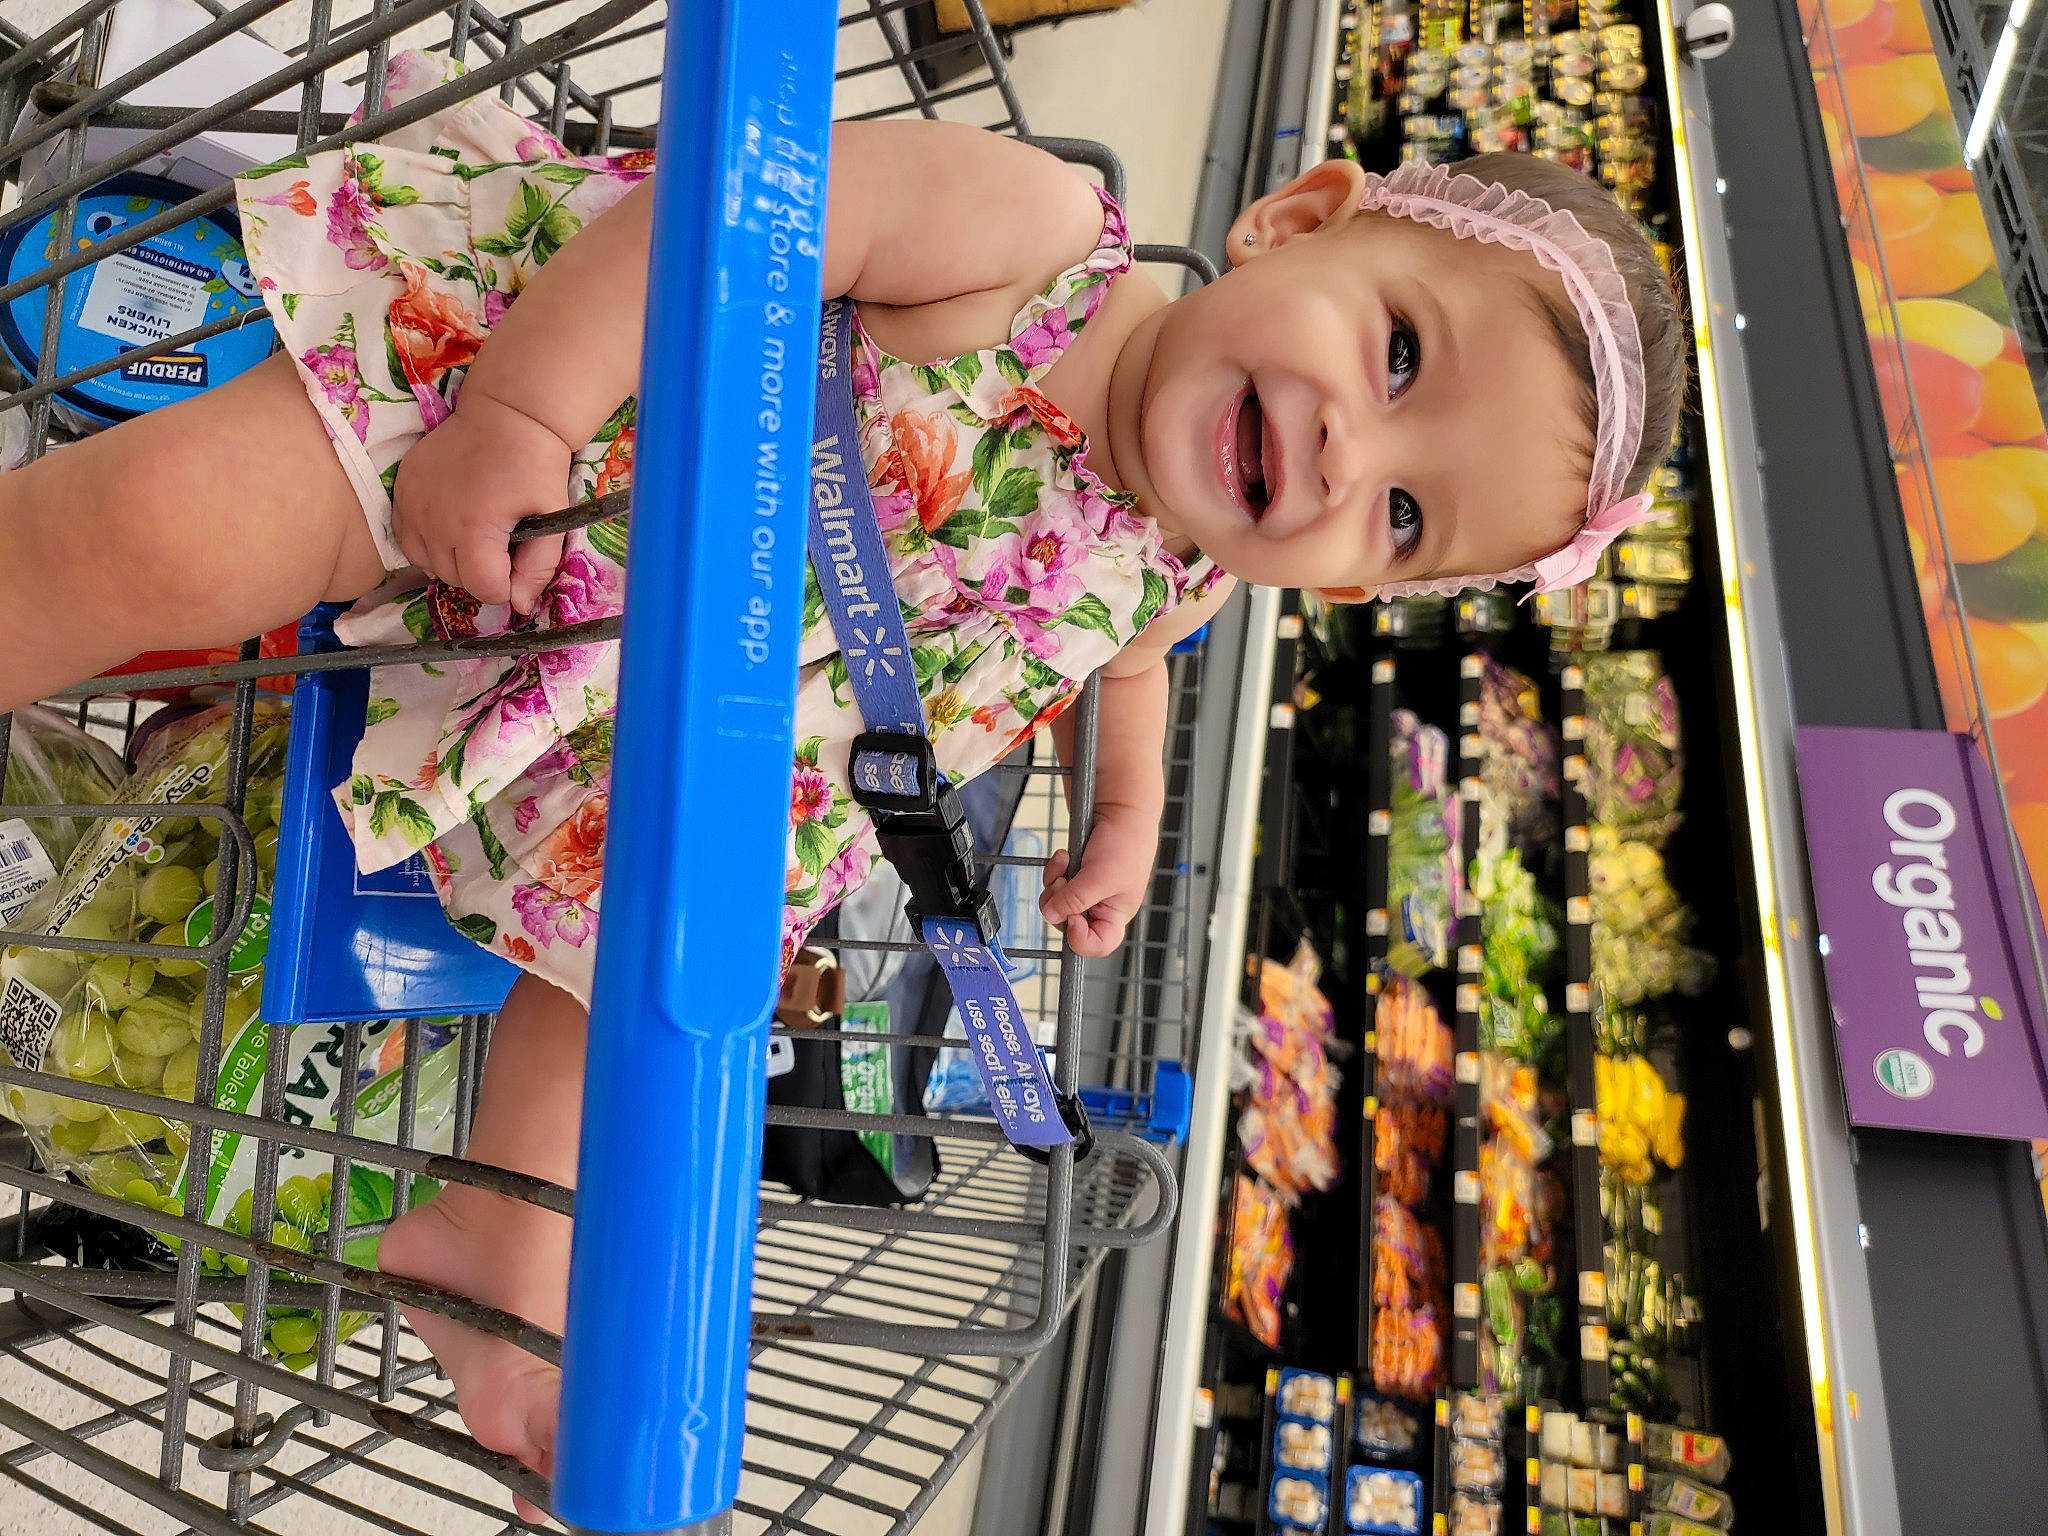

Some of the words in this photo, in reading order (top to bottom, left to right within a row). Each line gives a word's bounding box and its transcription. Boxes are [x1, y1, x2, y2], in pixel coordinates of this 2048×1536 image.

[139, 250, 195, 275] ANTIBIOTICS
[766, 204, 795, 293] store
[117, 305, 172, 329] LIVERS
[763, 302, 799, 328] &
[818, 302, 844, 380] Always
[127, 361, 203, 384] PERDUE
[757, 338, 786, 433] more
[753, 441, 787, 517] with
[750, 525, 777, 590] our
[811, 434, 881, 619] Walmart
[736, 595, 773, 672] app.
[134, 766, 210, 834] daya
[1871, 788, 2003, 1058] Organic
[965, 999, 985, 1030] use
[976, 1034, 1005, 1071] seat
[988, 996, 1024, 1057] Please:
[224, 1050, 261, 1096] Table
